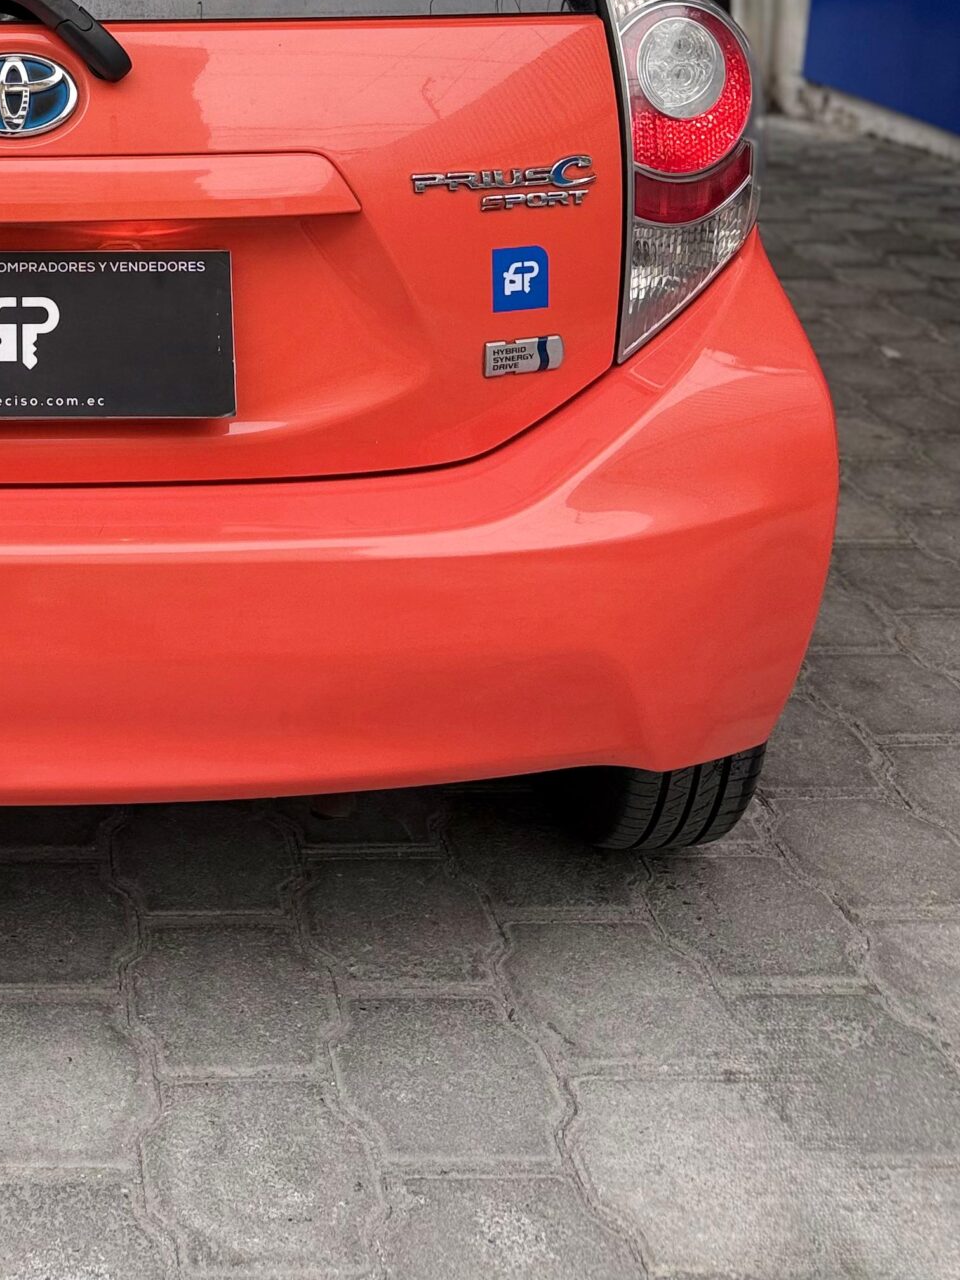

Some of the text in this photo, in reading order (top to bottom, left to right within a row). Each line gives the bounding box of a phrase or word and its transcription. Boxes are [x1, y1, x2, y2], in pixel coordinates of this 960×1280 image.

[481, 189, 589, 211] SPORT
[98, 262, 107, 272] Y
[109, 261, 206, 272] VENDEDORES
[492, 346, 527, 356] HYBRID
[492, 353, 535, 364] SYNERGY
[492, 362, 519, 371] DRIVE
